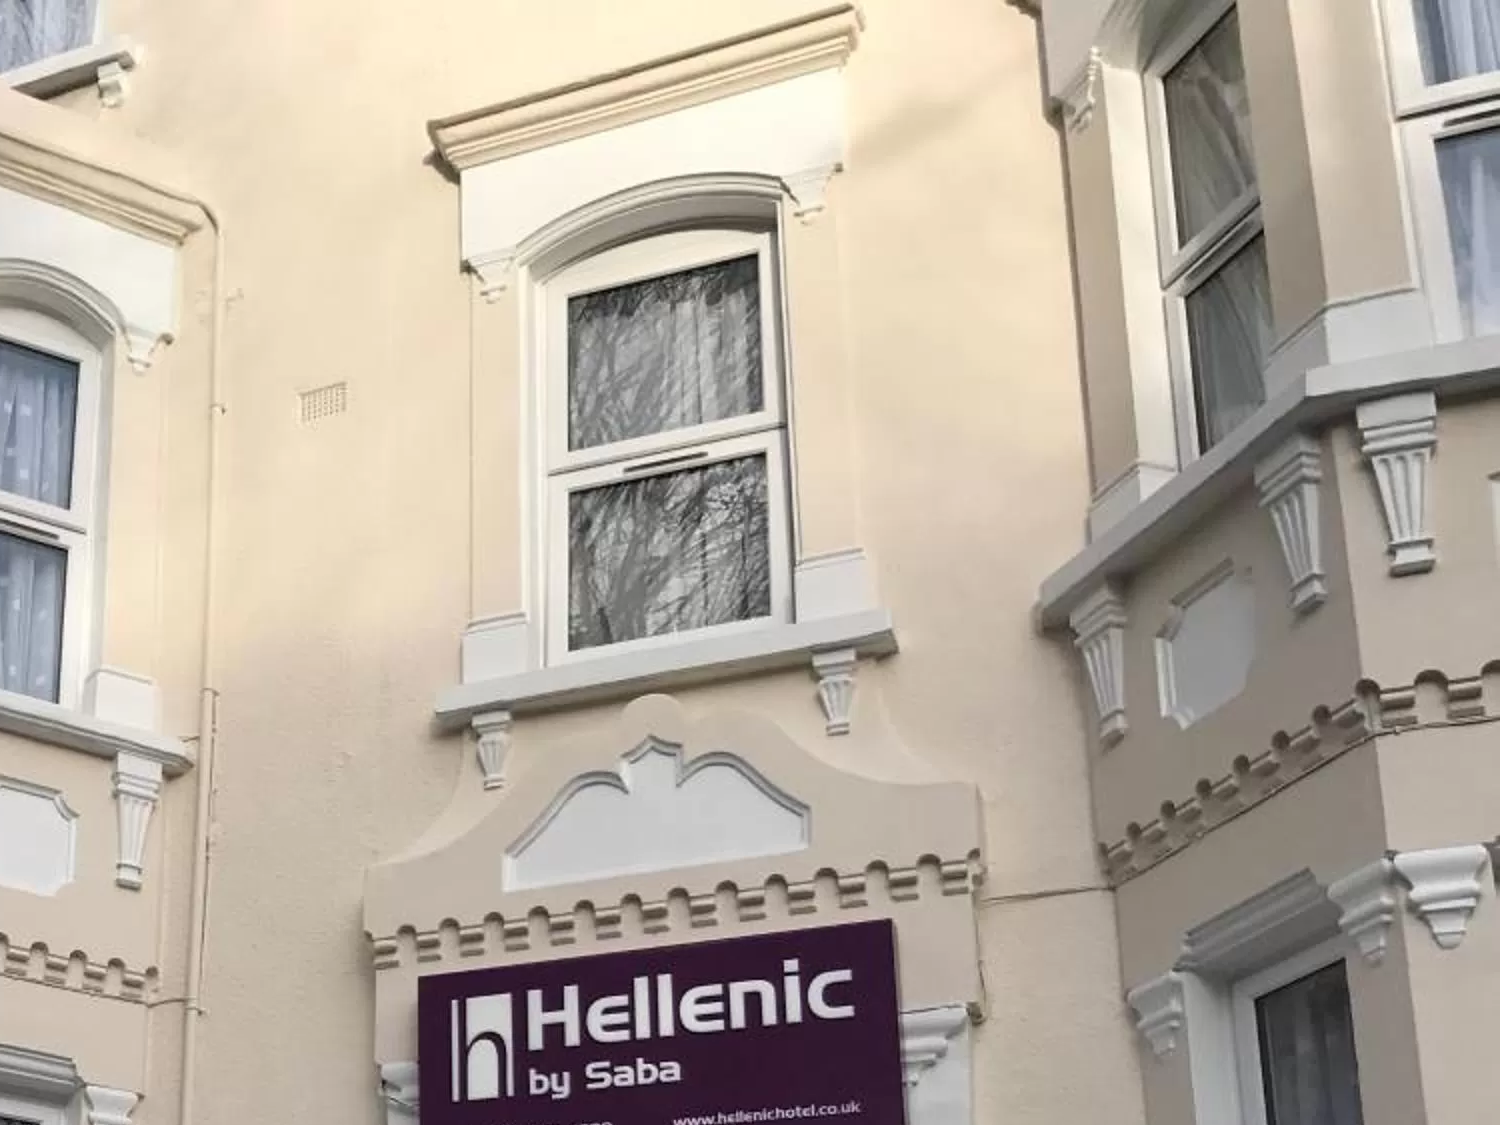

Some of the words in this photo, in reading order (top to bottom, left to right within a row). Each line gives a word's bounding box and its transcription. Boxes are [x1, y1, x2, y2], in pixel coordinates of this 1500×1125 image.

[528, 958, 855, 1051] Hellenic
[528, 1067, 571, 1099] by
[585, 1058, 682, 1090] Saba
